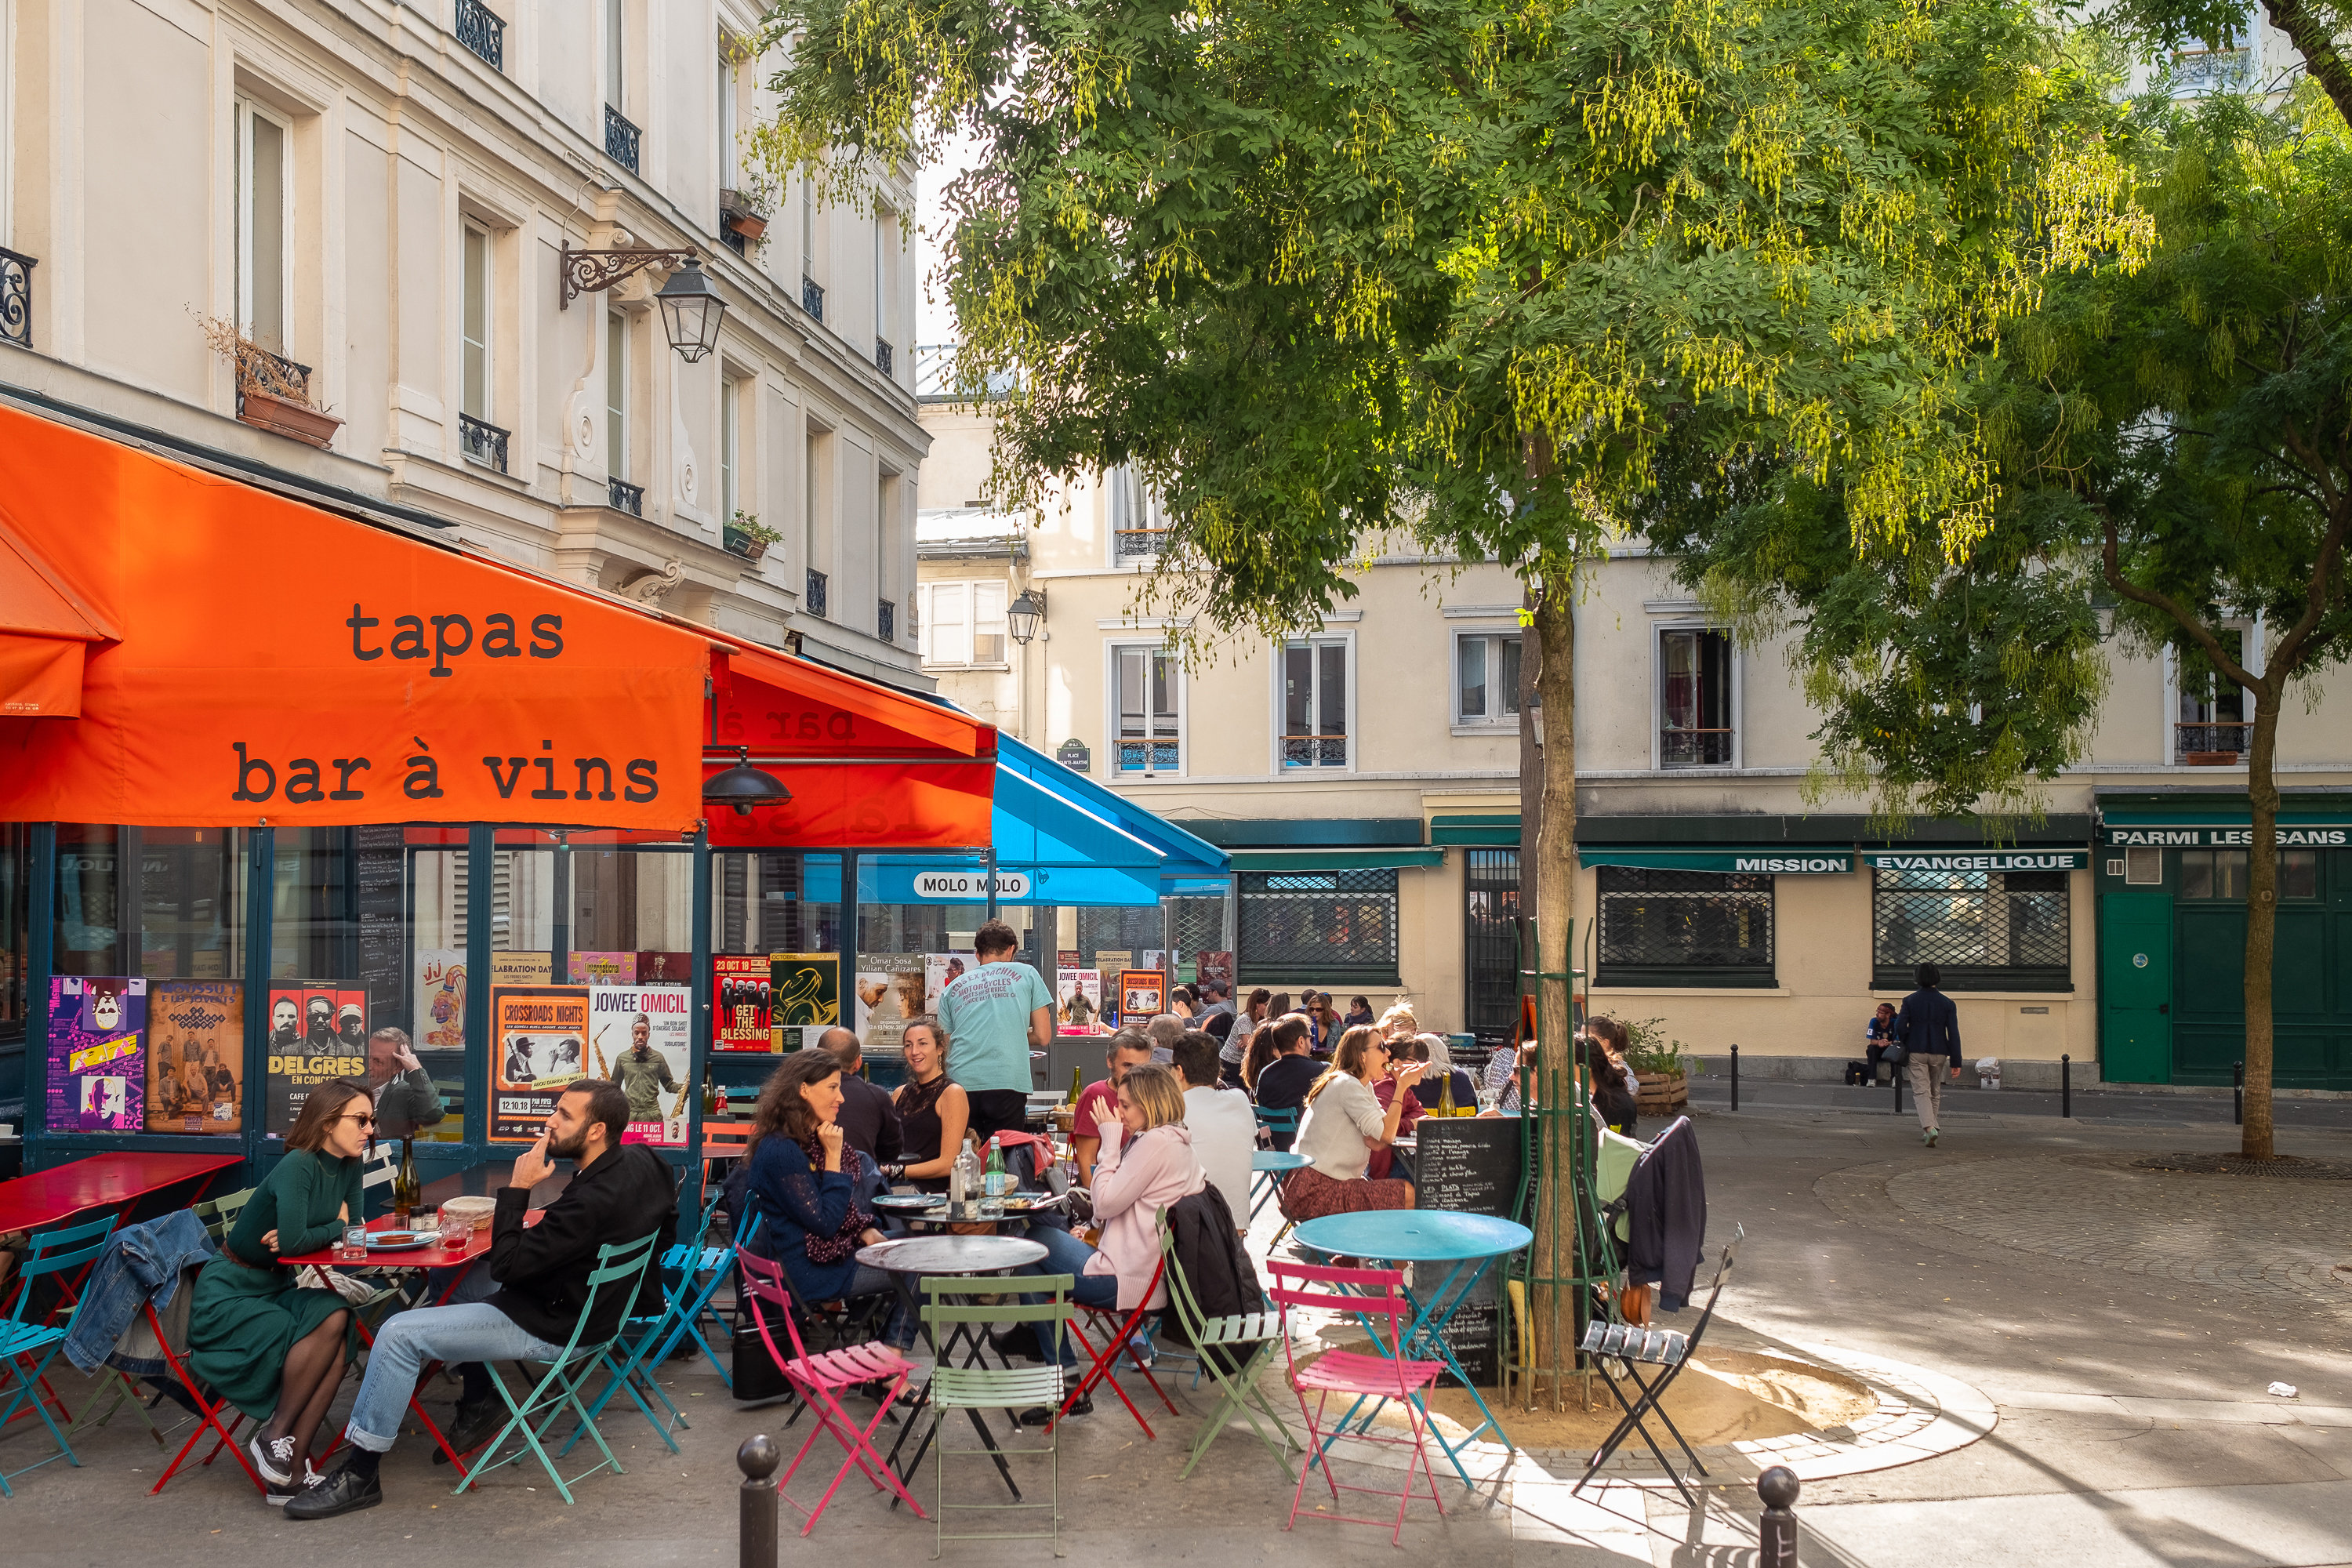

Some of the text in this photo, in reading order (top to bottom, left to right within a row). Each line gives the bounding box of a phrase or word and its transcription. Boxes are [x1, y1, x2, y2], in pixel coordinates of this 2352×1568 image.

[346, 601, 564, 677] tapas
[231, 735, 659, 804] bar à vins
[2112, 831, 2347, 844] PARMI LES SANS
[1735, 855, 2075, 872] MISSION EVANGELIQUE
[924, 878, 968, 892] MOLO
[717, 960, 725, 971] 23
[727, 960, 739, 971] OCT
[741, 961, 749, 971] 18
[950, 967, 1022, 997] DEUS EX MACHINA
[1058, 972, 1098, 981] JOWEE OMICIL
[958, 978, 1011, 997] MOTORCYCLES
[594, 993, 688, 1013] JOWEE OMICIL
[505, 1004, 583, 1022] CROSSROADS NIGHTS
[736, 1004, 756, 1017] GET
[735, 1017, 755, 1028] THE
[721, 1029, 769, 1040] BLESSING
[268, 1055, 365, 1076] DELGRES
[292, 1076, 302, 1084] EN
[502, 1101, 528, 1110] 12.10.18
